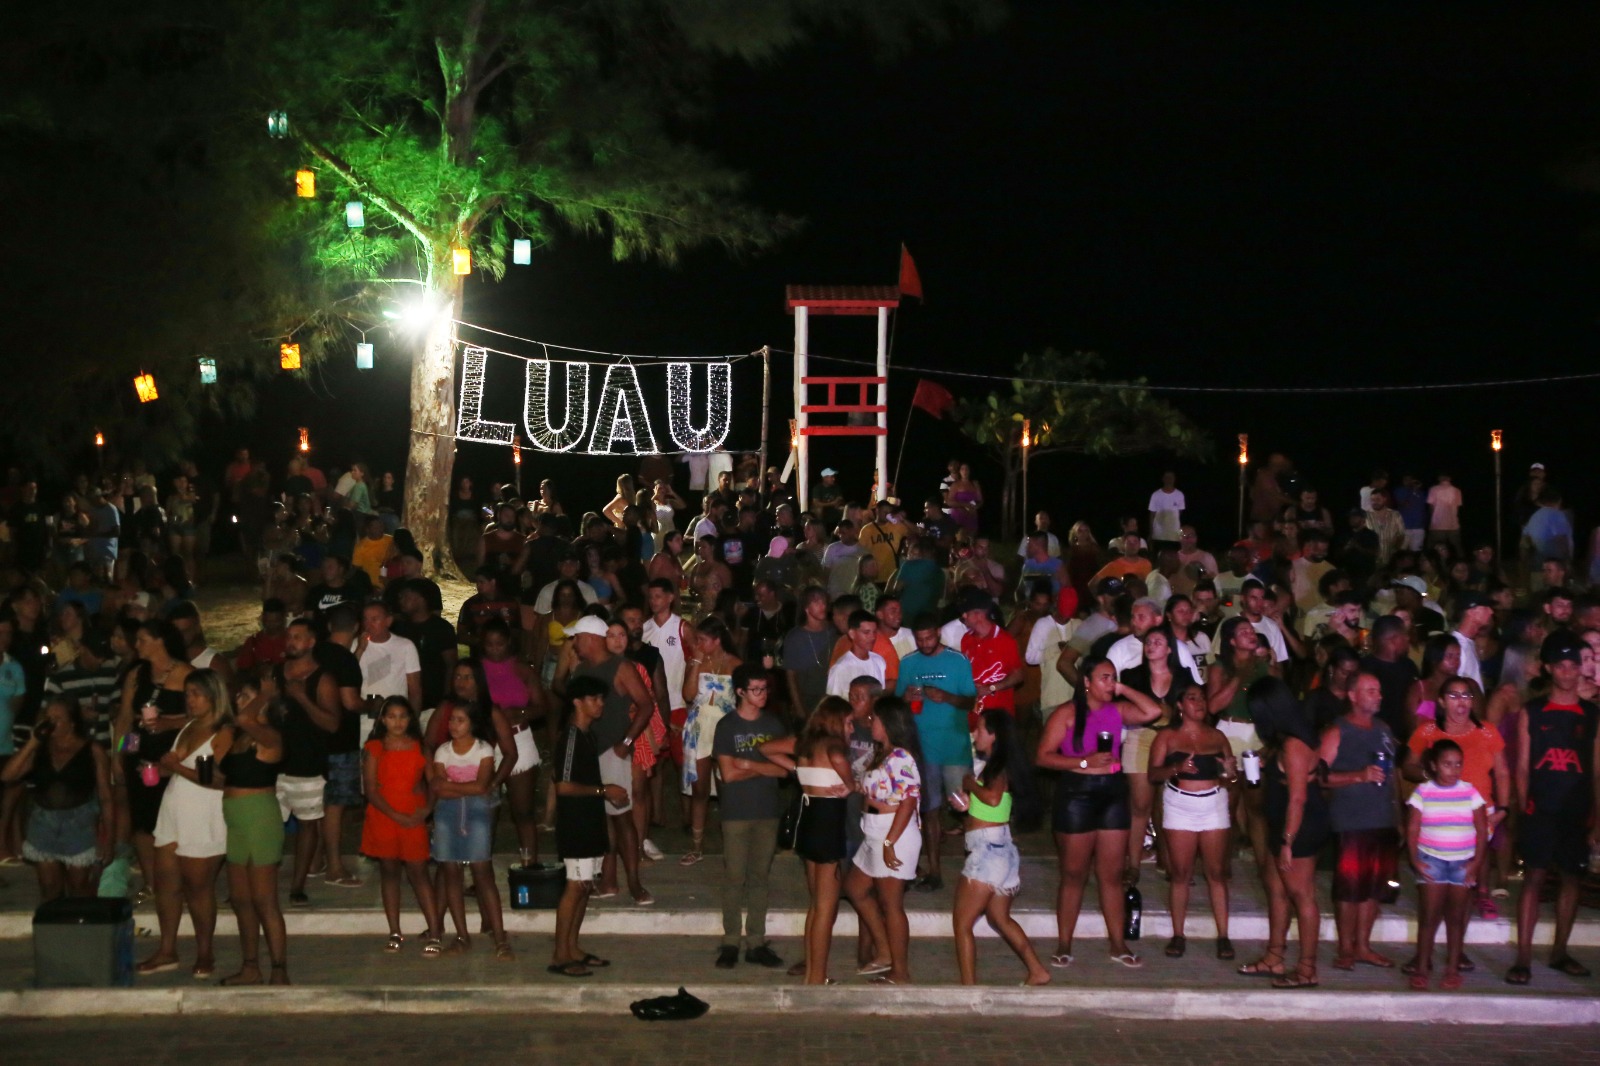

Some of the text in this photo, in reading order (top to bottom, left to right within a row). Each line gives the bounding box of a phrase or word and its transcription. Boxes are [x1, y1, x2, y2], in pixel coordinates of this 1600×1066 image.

[456, 346, 732, 456] LUAU
[323, 594, 343, 603] NIKE
[1534, 747, 1583, 774] AXA
